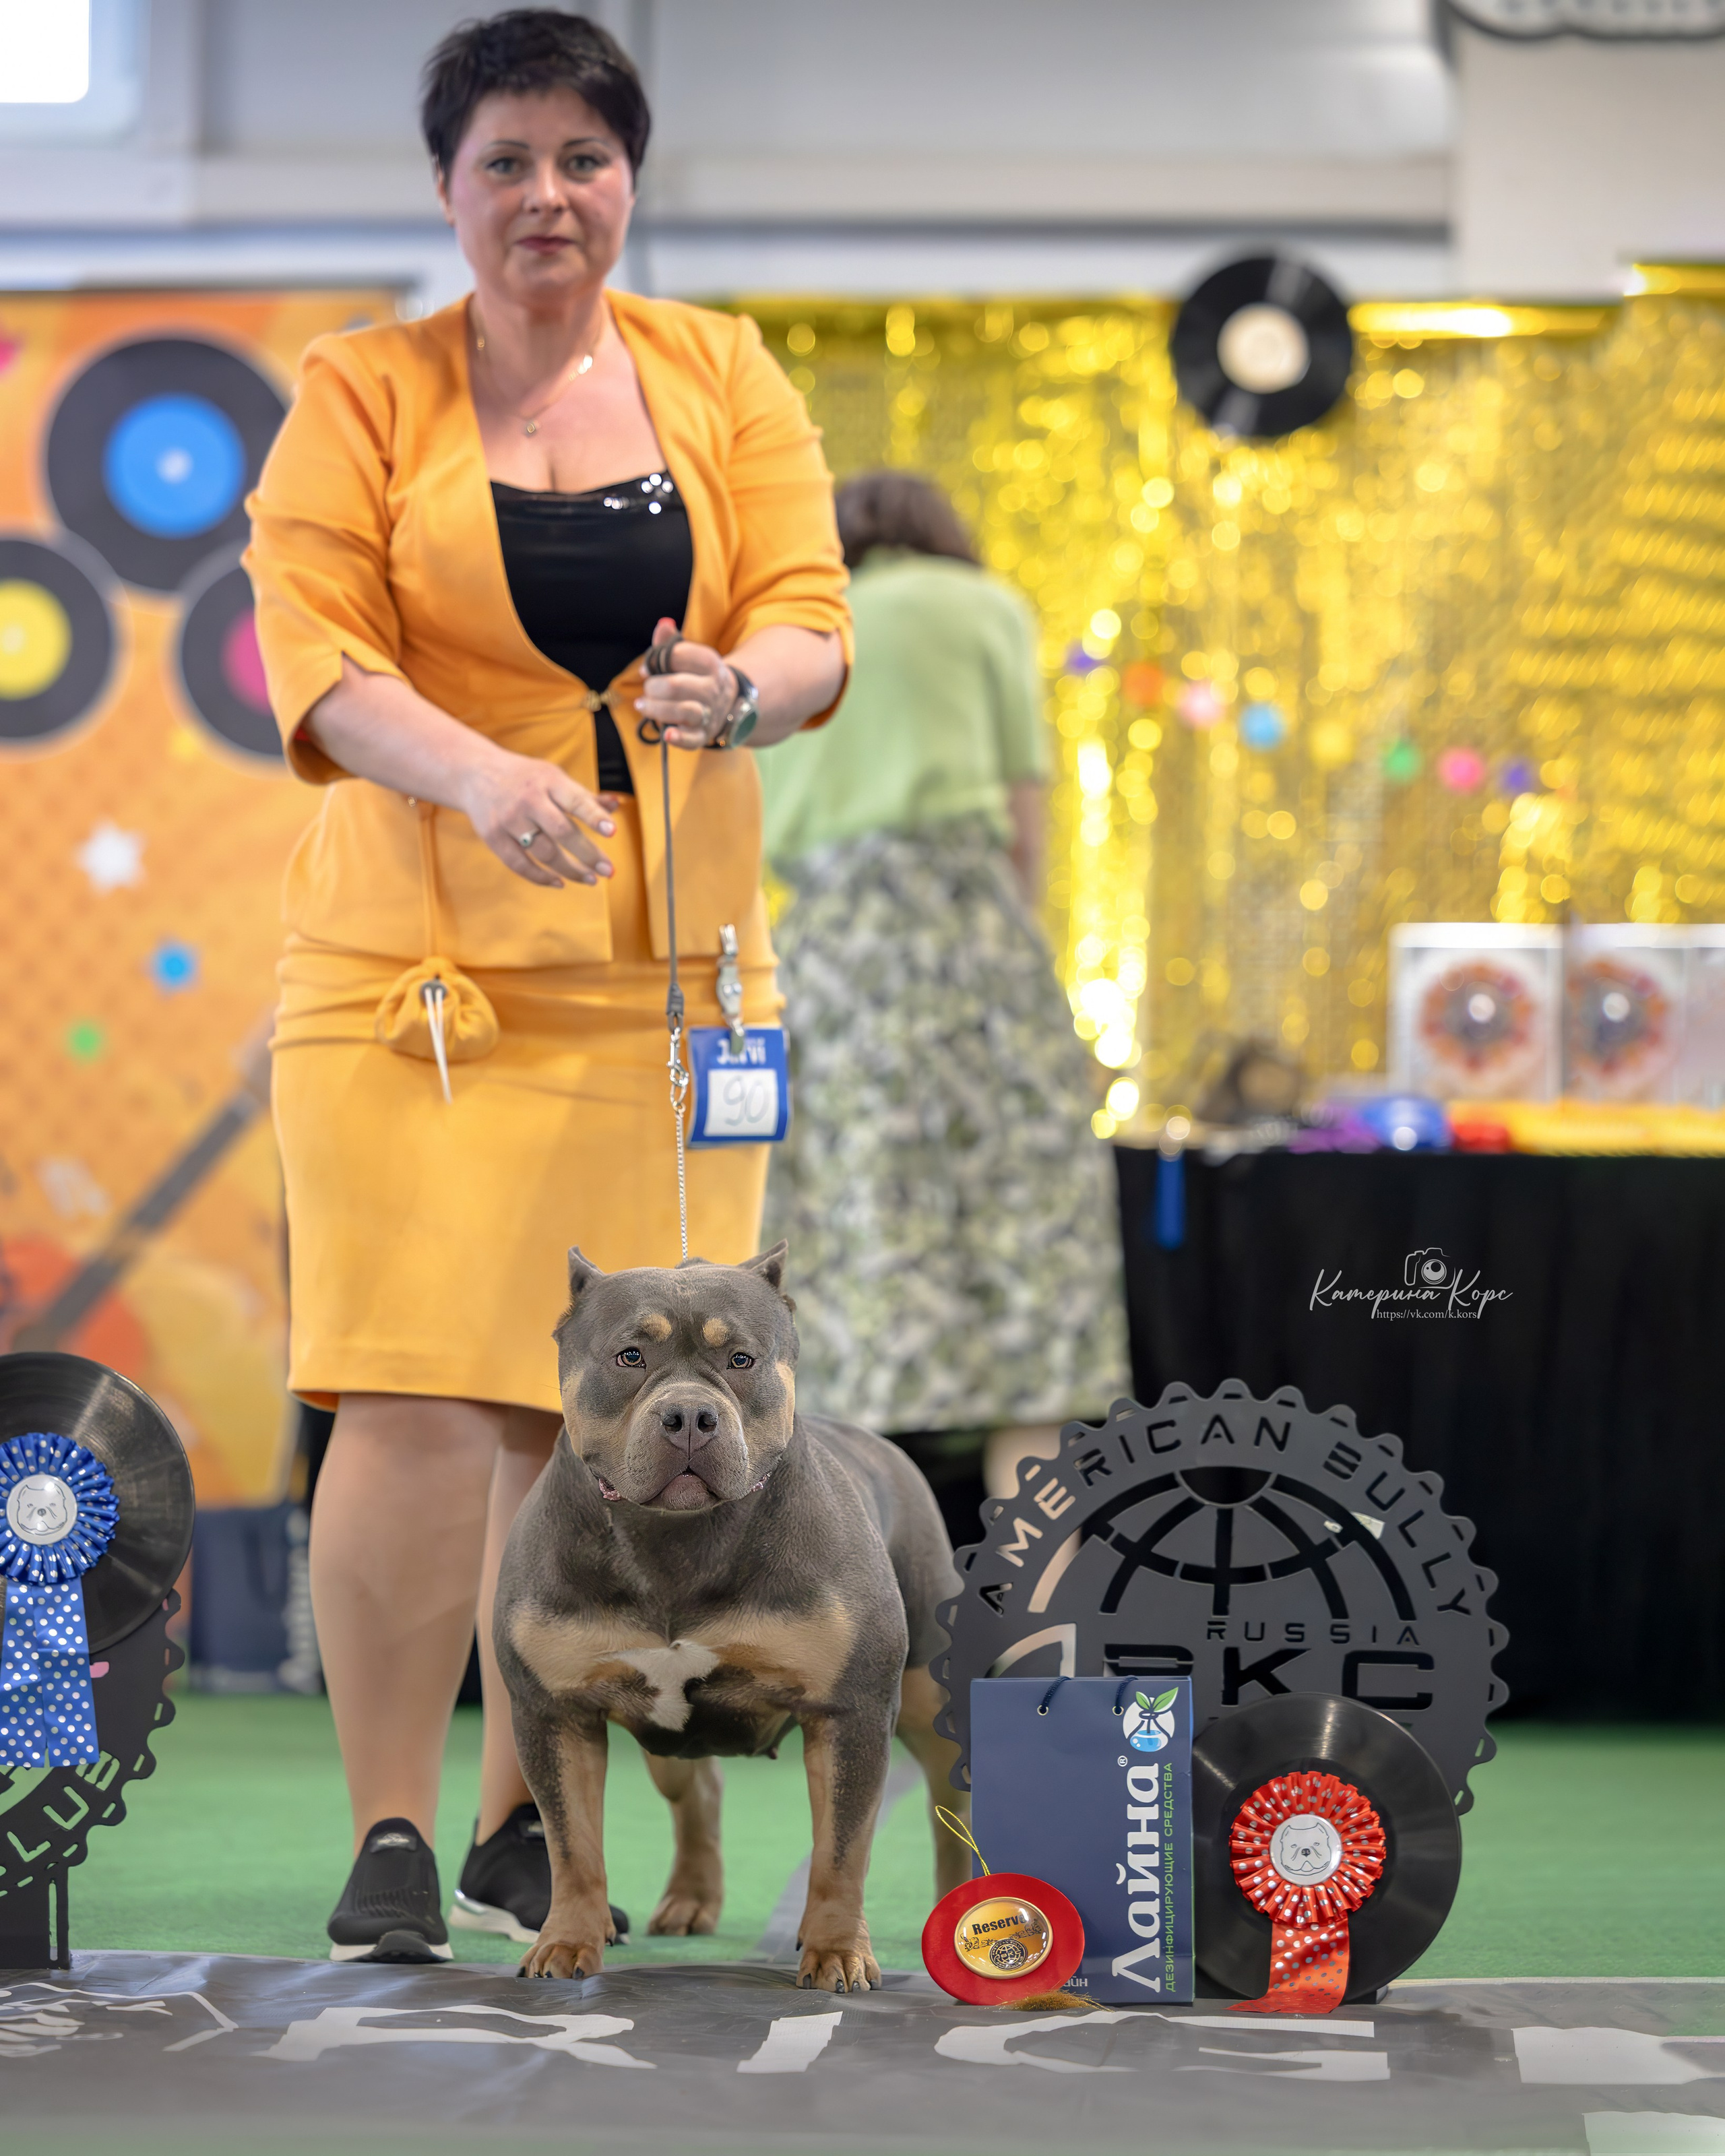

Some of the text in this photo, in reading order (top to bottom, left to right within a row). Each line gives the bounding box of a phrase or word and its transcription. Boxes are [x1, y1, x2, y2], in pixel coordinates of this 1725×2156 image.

[722, 1076, 770, 1127] 90
[978, 1414, 1472, 1617] AMERICAN BULLY
[1207, 1620, 1420, 1647] RUSSIA
[0, 1750, 121, 1877] LUB
[1112, 1763, 1161, 1993] Лайна
[1164, 1763, 1177, 1992] ДЕЗИНФИЦИРУЮЩИЕ СРЕДСТВА
